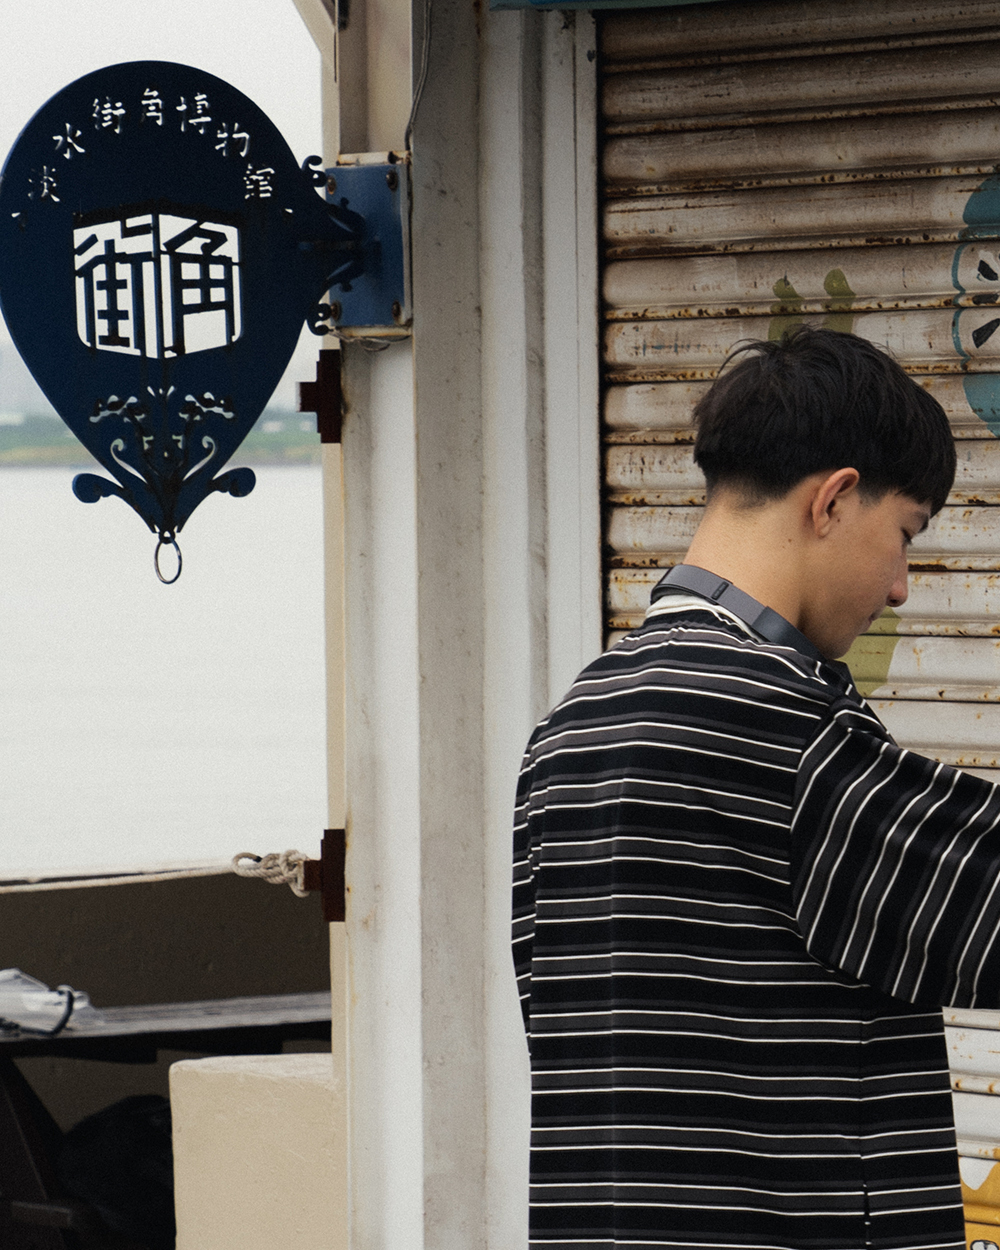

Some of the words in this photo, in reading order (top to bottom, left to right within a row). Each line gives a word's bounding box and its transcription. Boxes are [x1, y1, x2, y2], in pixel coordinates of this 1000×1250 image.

[28, 88, 275, 203] 淡水街角博物館
